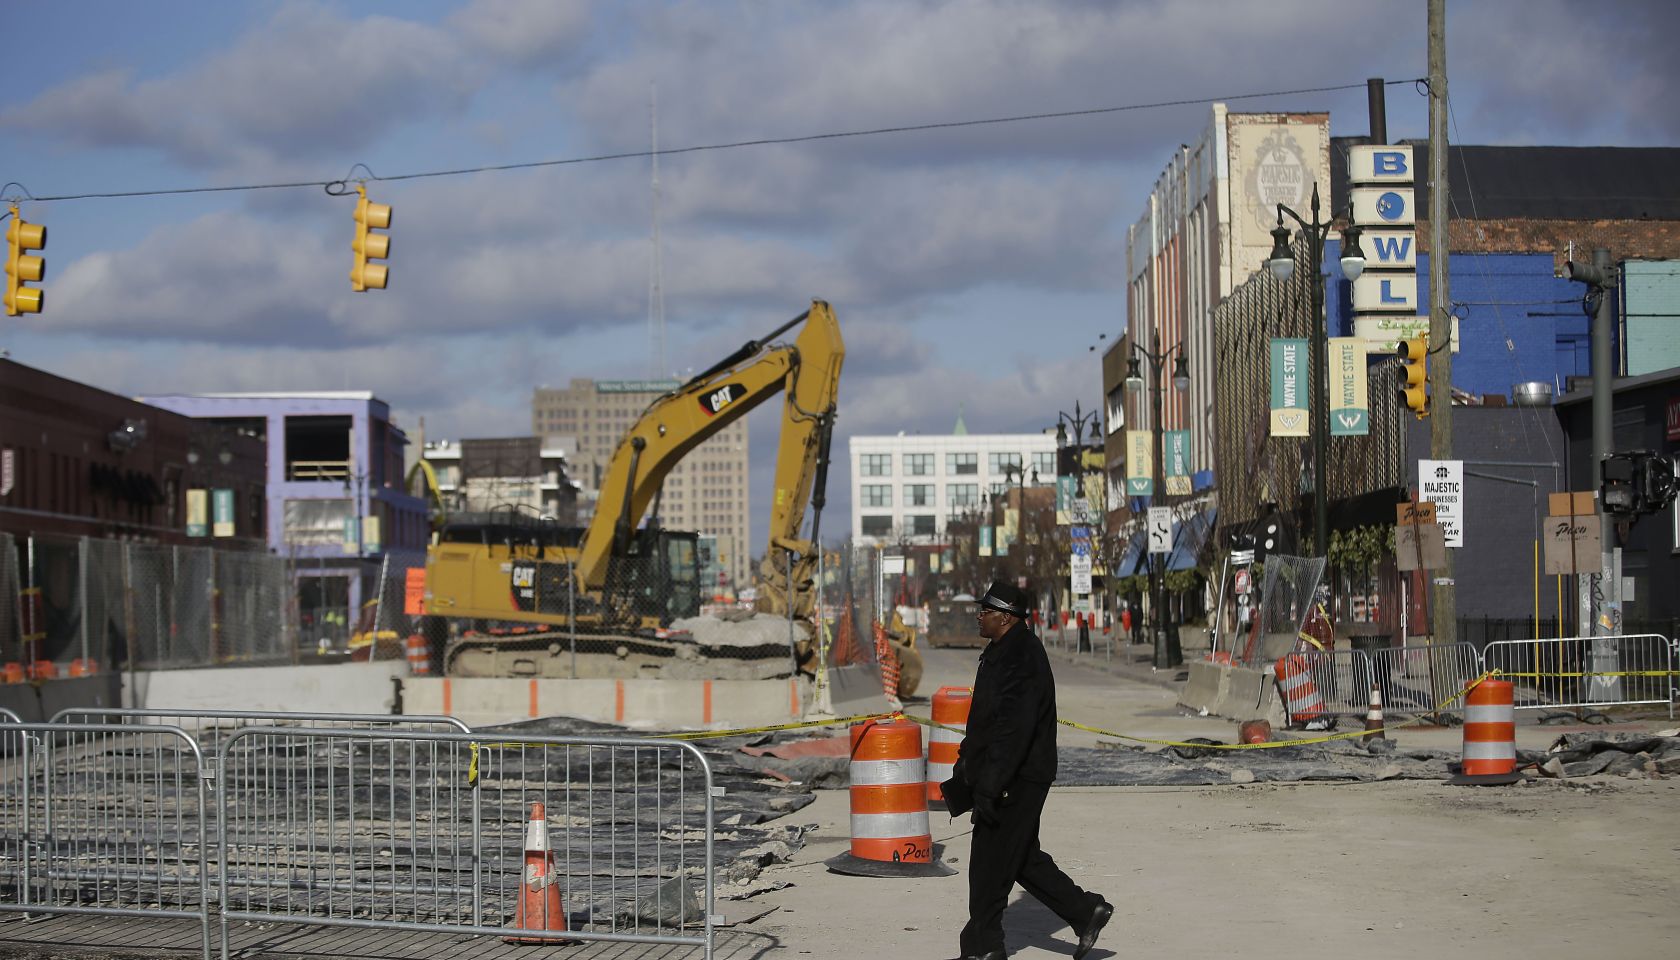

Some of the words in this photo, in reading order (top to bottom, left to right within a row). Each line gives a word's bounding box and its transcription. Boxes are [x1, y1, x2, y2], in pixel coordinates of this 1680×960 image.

[1284, 344, 1296, 373] STATE
[1342, 344, 1354, 372] STATE
[710, 386, 732, 412] CAT
[1284, 375, 1296, 408] WAYNE
[1343, 374, 1355, 406] WAYNE
[1424, 482, 1460, 493] MAJESTIC
[1426, 495, 1458, 503] BUSINESSES
[513, 566, 535, 587] CAT
